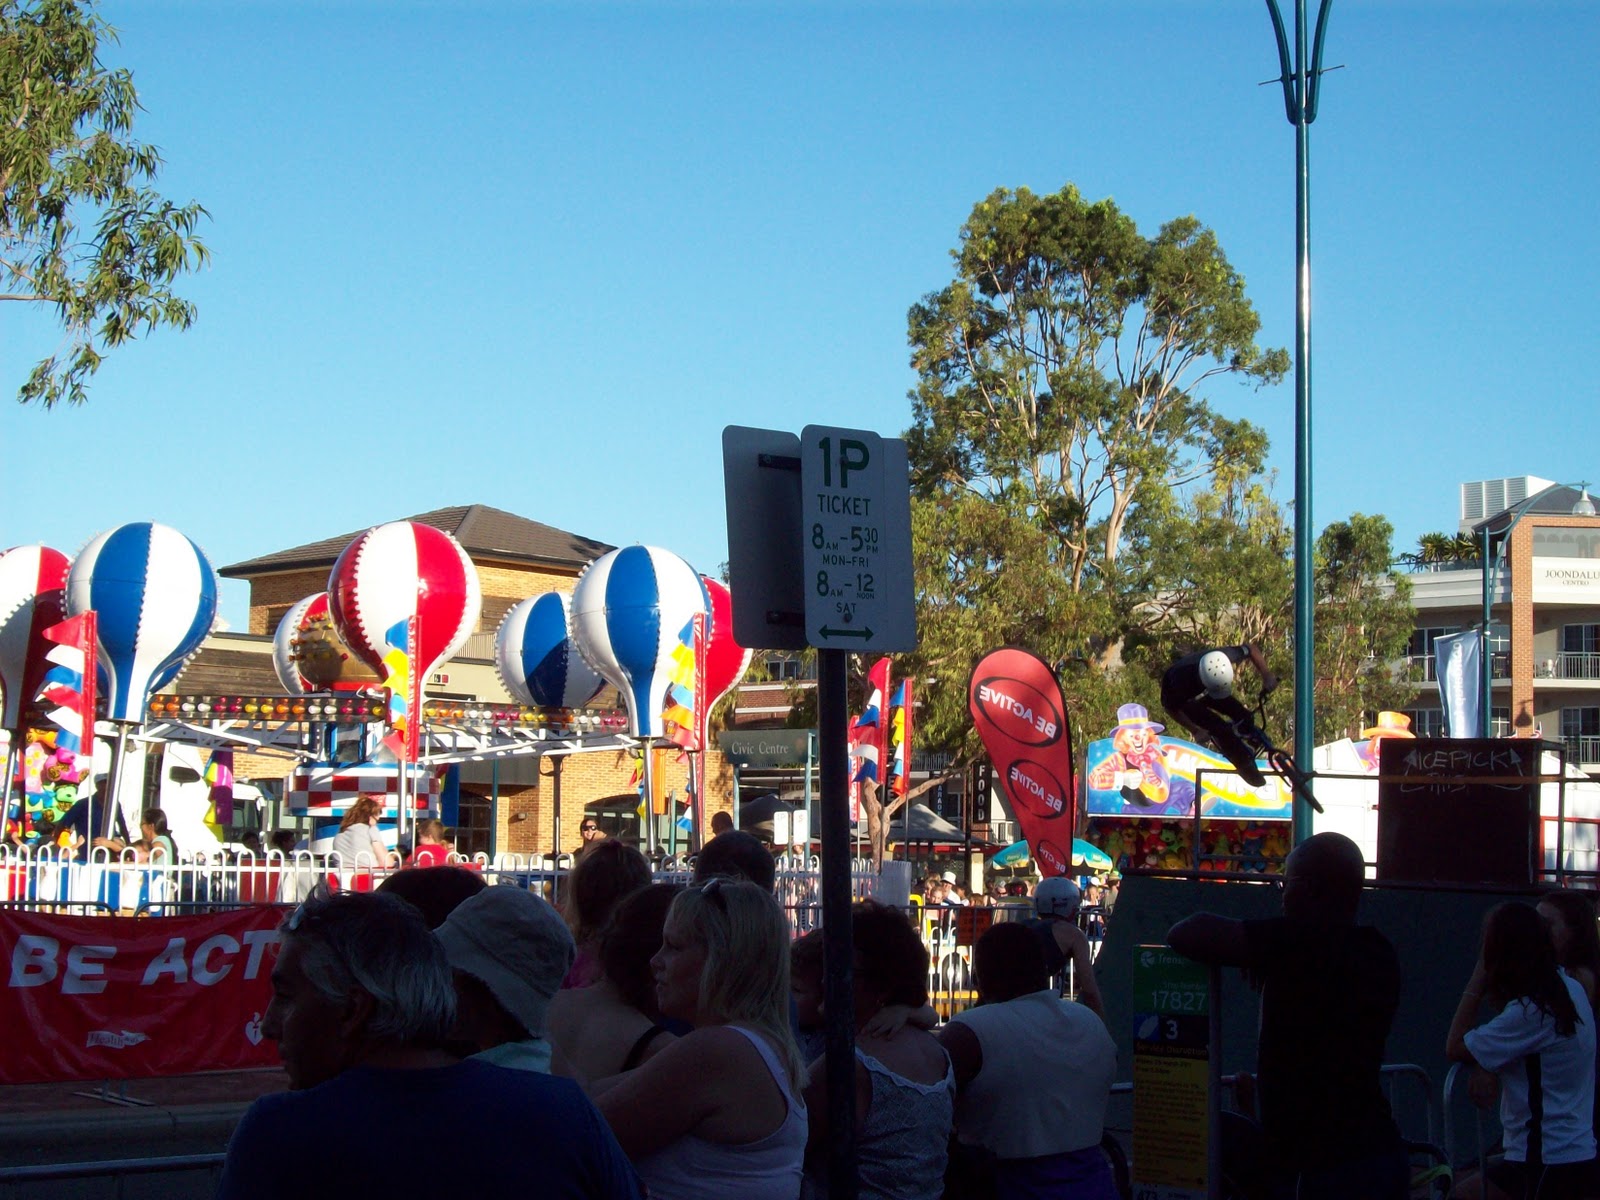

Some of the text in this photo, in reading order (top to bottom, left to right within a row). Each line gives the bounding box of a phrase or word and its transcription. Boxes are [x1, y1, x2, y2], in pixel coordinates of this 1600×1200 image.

[819, 437, 870, 488] 1P
[817, 494, 871, 516] TICKET
[822, 554, 869, 567] MON-FRI
[836, 602, 857, 614] SAT
[731, 741, 789, 755] Civic Centre
[1417, 750, 1508, 770] ICEPICK
[977, 764, 985, 821] FOOD
[8, 929, 281, 995] BE ACT
[1151, 990, 1206, 1011] 17827
[1166, 1019, 1178, 1040] 3
